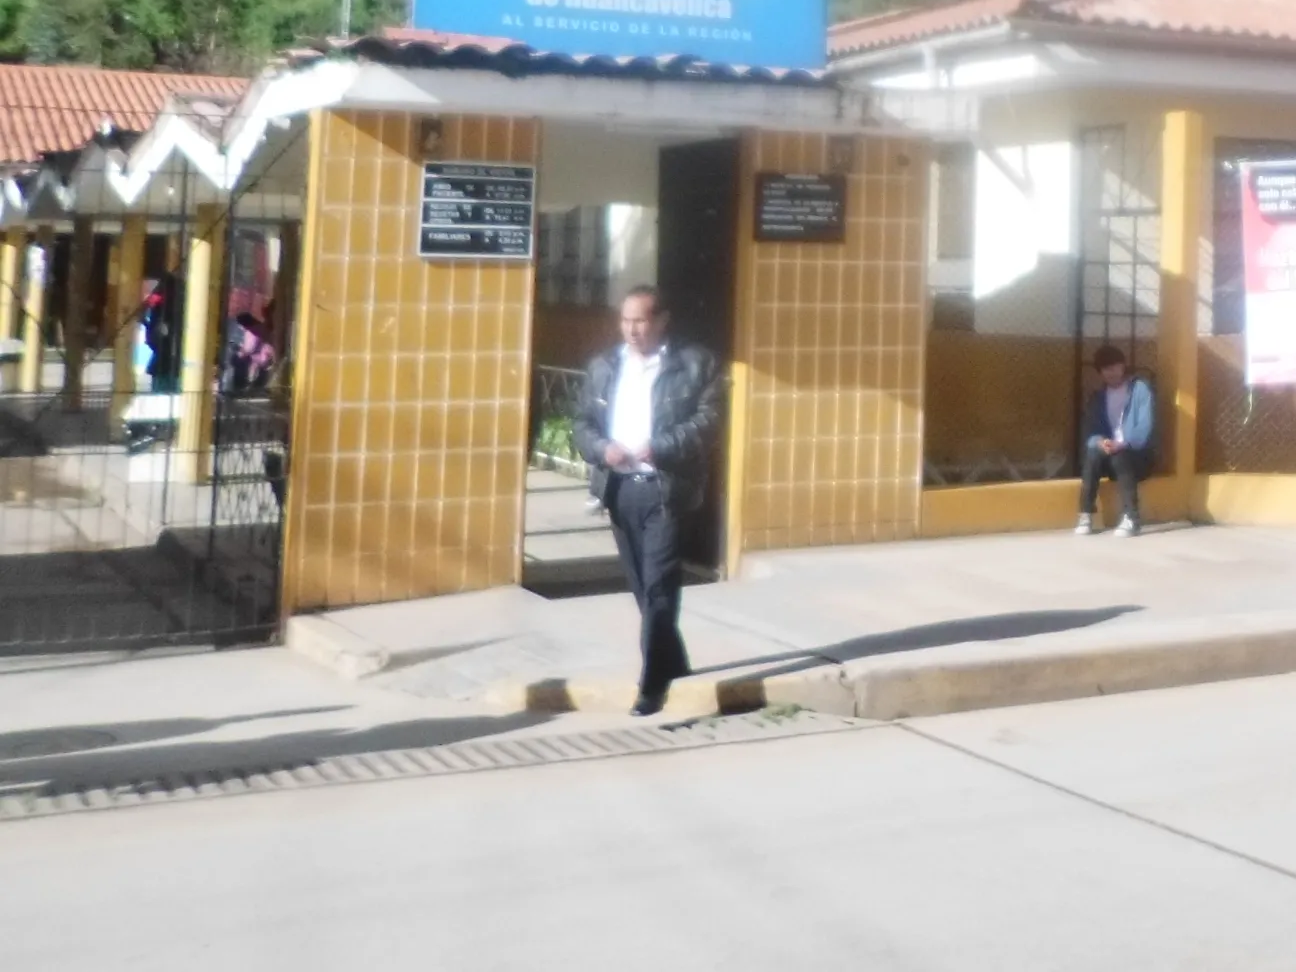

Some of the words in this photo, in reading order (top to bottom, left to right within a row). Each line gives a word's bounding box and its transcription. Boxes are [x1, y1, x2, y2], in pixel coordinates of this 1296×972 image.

[502, 13, 524, 27] AL
[532, 16, 621, 33] SERVICIO
[628, 22, 652, 35] DE
[659, 24, 680, 36] LA
[687, 26, 754, 41] REGIÓN
[1258, 175, 1296, 187] Aunque
[1258, 201, 1277, 211] con
